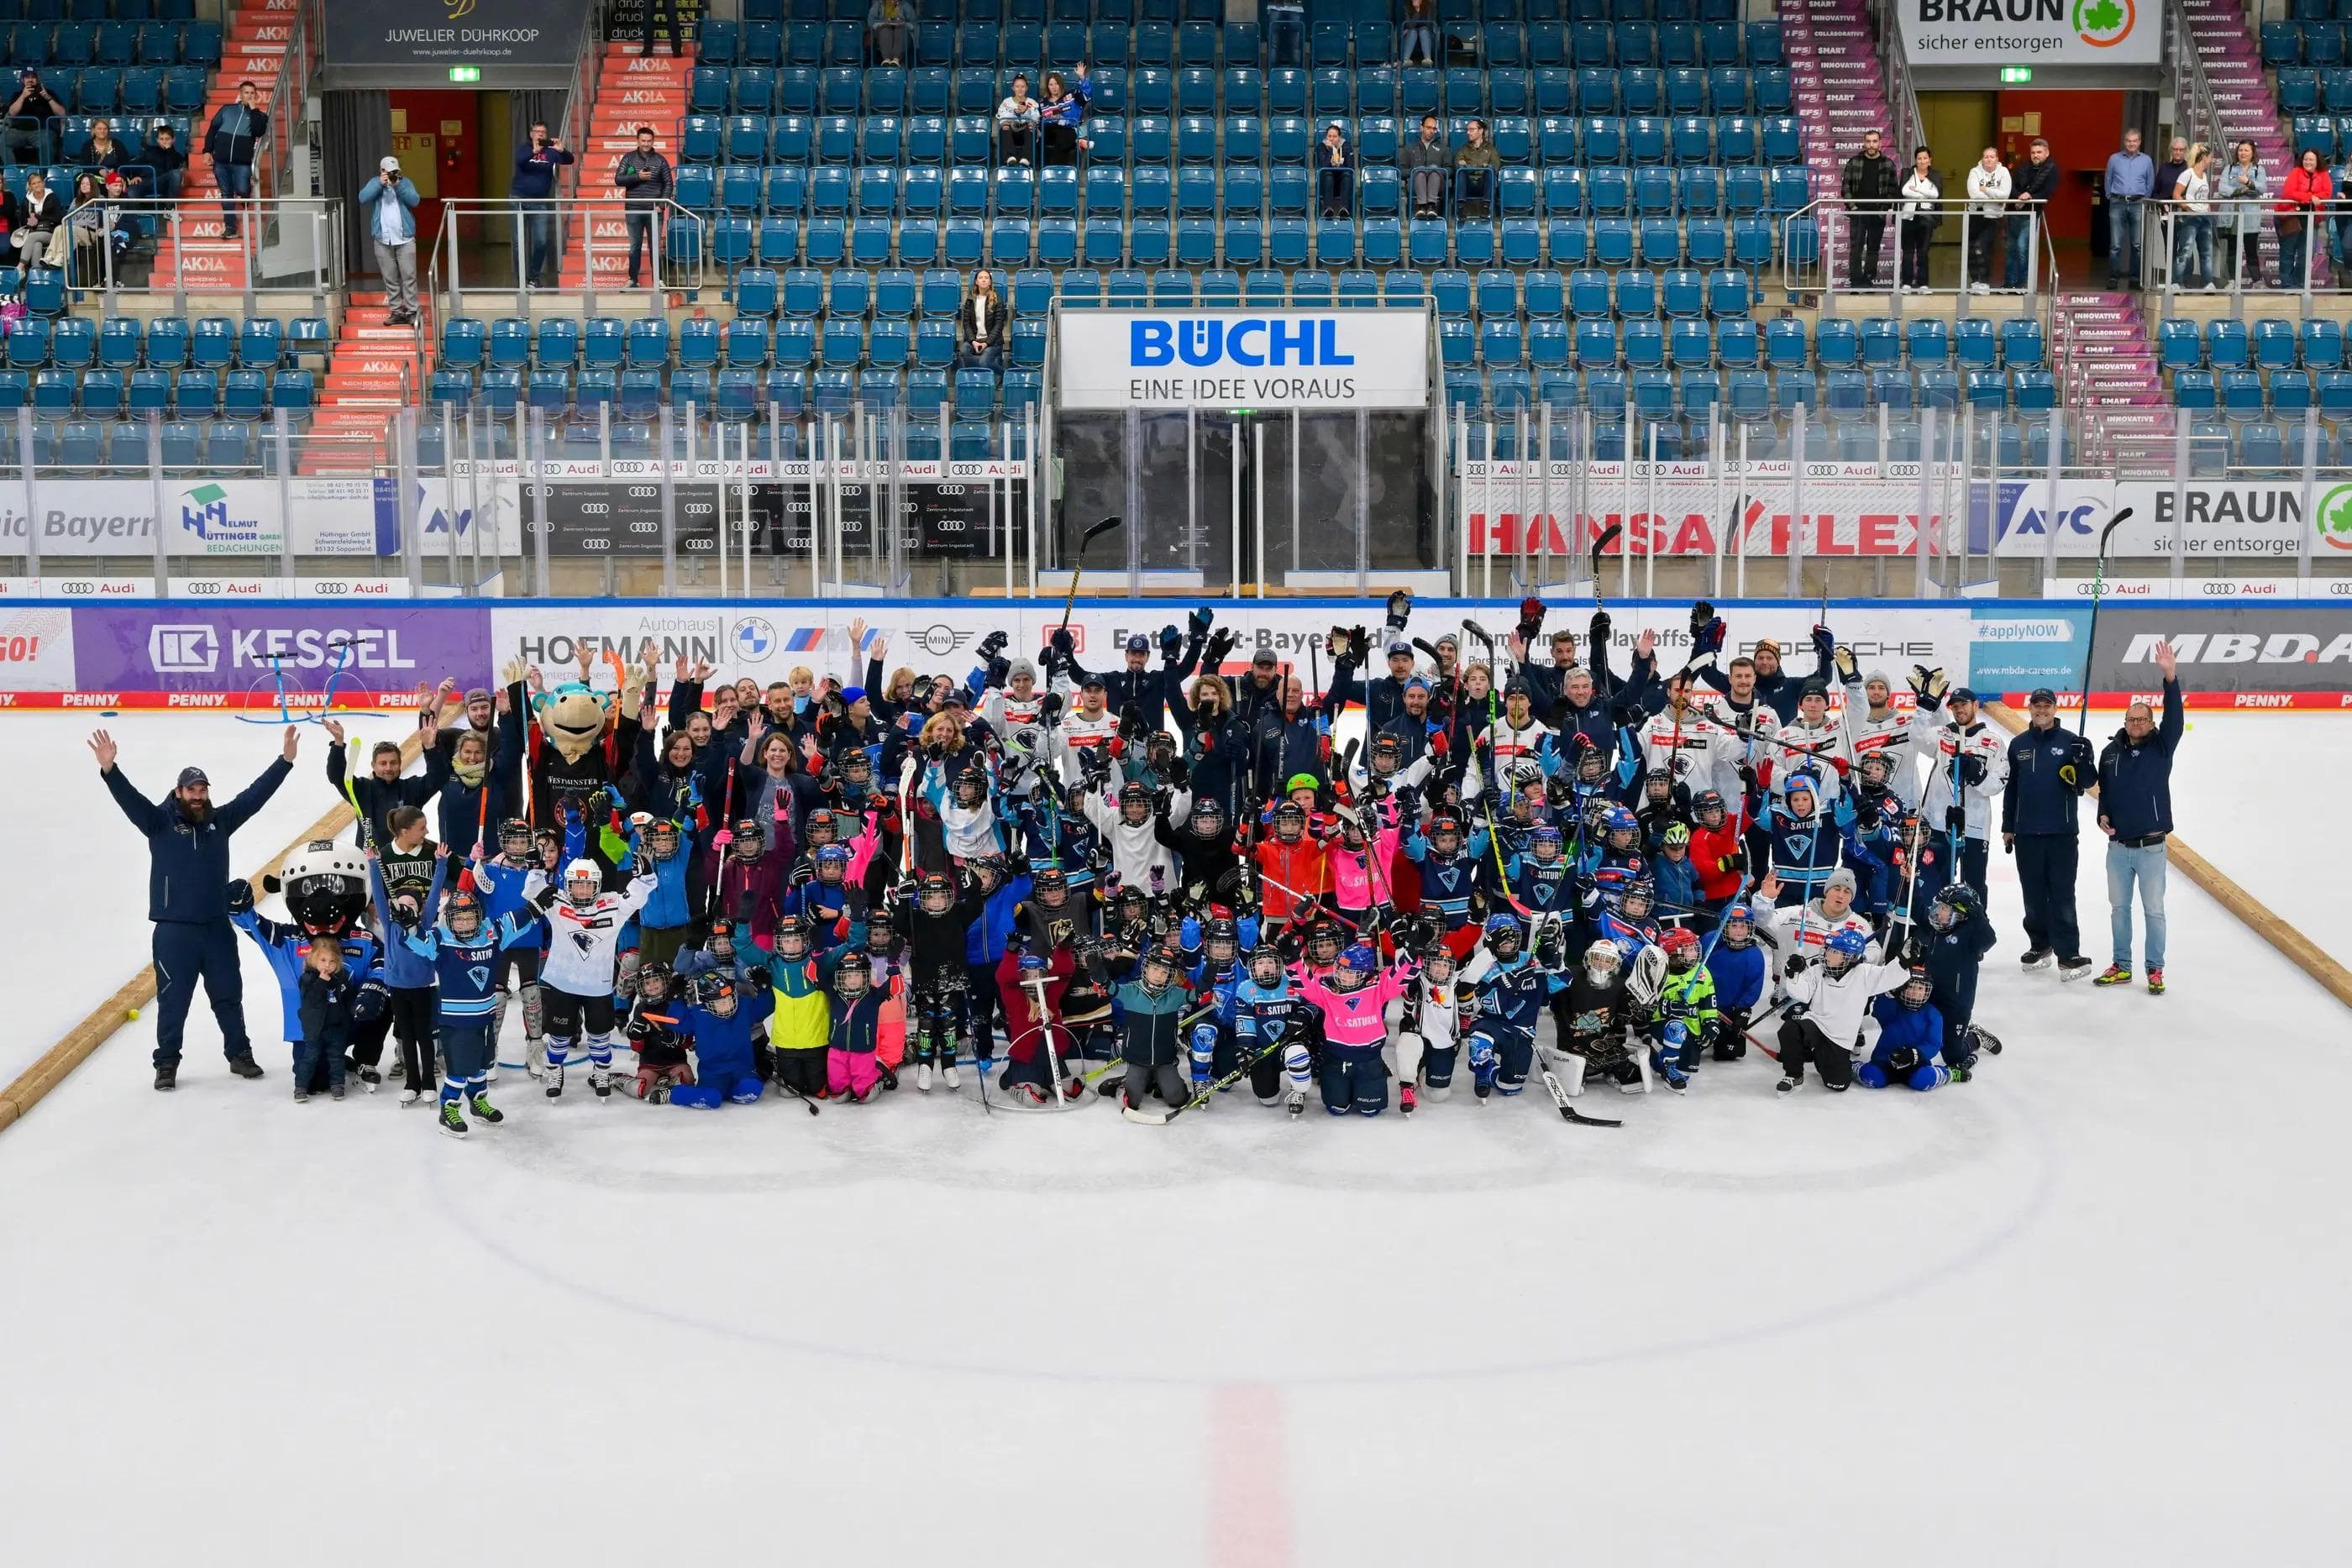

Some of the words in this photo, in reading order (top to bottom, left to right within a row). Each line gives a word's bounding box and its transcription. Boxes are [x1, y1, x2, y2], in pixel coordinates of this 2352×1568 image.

[1919, 0, 2064, 22] BRAUN
[386, 29, 454, 42] JUWELIER
[461, 28, 539, 42] DÜHRKOOP
[1919, 35, 1968, 50] sicher
[1975, 36, 2063, 53] entsorgen
[412, 48, 512, 56] www.juwelier-duehrkoop.de
[628, 58, 671, 71] AKKA
[622, 90, 666, 103] AKKA
[1131, 319, 1355, 367] BÜCHL
[362, 361, 398, 373] AKKA
[1131, 379, 1184, 401] EINE
[1193, 379, 1246, 401] IDEE
[1253, 378, 1355, 401] VORAUS
[567, 464, 600, 474] Audi
[902, 464, 936, 475] Audi
[1588, 464, 1620, 475] Audi
[1672, 464, 1704, 475] Audi
[1758, 462, 1791, 472] Audi
[1844, 465, 1877, 475] Audi
[207, 544, 283, 553] BEDACHUNGEN
[101, 584, 135, 594] Audi
[228, 584, 262, 594] Audi
[354, 584, 389, 594] Audi
[2116, 584, 2150, 595] Audi
[2242, 584, 2276, 595] Audi
[638, 616, 715, 632] Autohaus
[1978, 624, 2059, 640] #applyNOW
[928, 635, 953, 645] MINI
[232, 628, 416, 669] KESSEL
[1977, 666, 2072, 675] www.mbda-careers.de
[1346, 1014, 1378, 1028] SATURN
